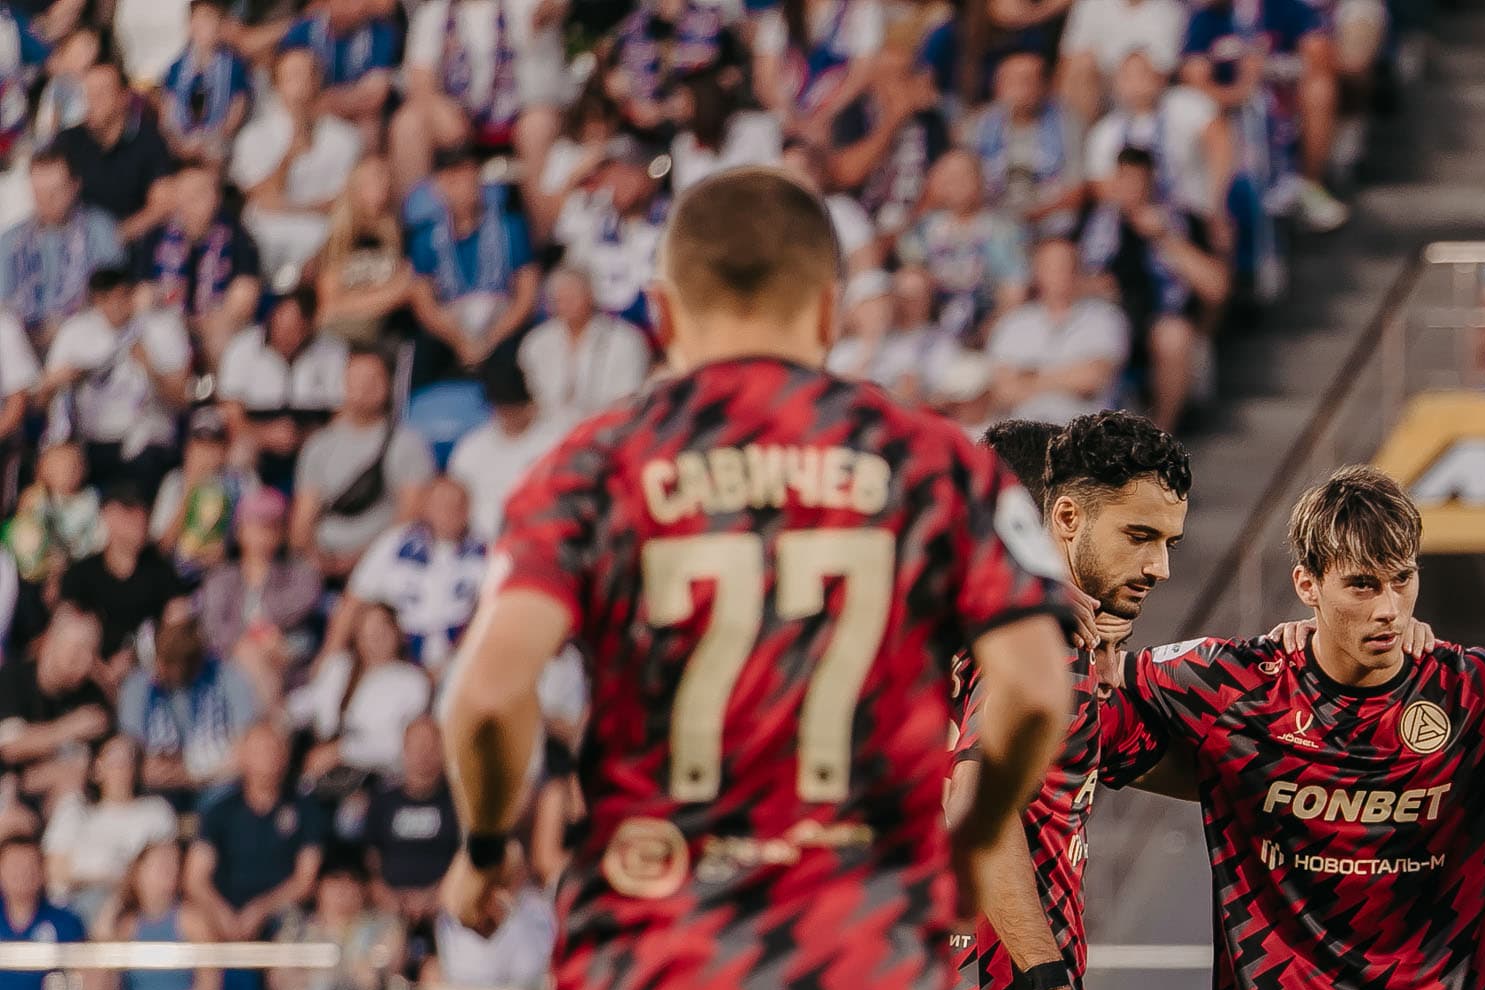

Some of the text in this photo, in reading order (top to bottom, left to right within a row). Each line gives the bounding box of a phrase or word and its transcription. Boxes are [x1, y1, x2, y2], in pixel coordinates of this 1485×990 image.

[642, 444, 892, 525] САВИЧЕВ
[641, 528, 897, 802] 77
[1277, 733, 1319, 749] JÖGEL
[1262, 780, 1452, 823] FONBET
[1294, 853, 1446, 876] НОВОСТАЛЬ-М
